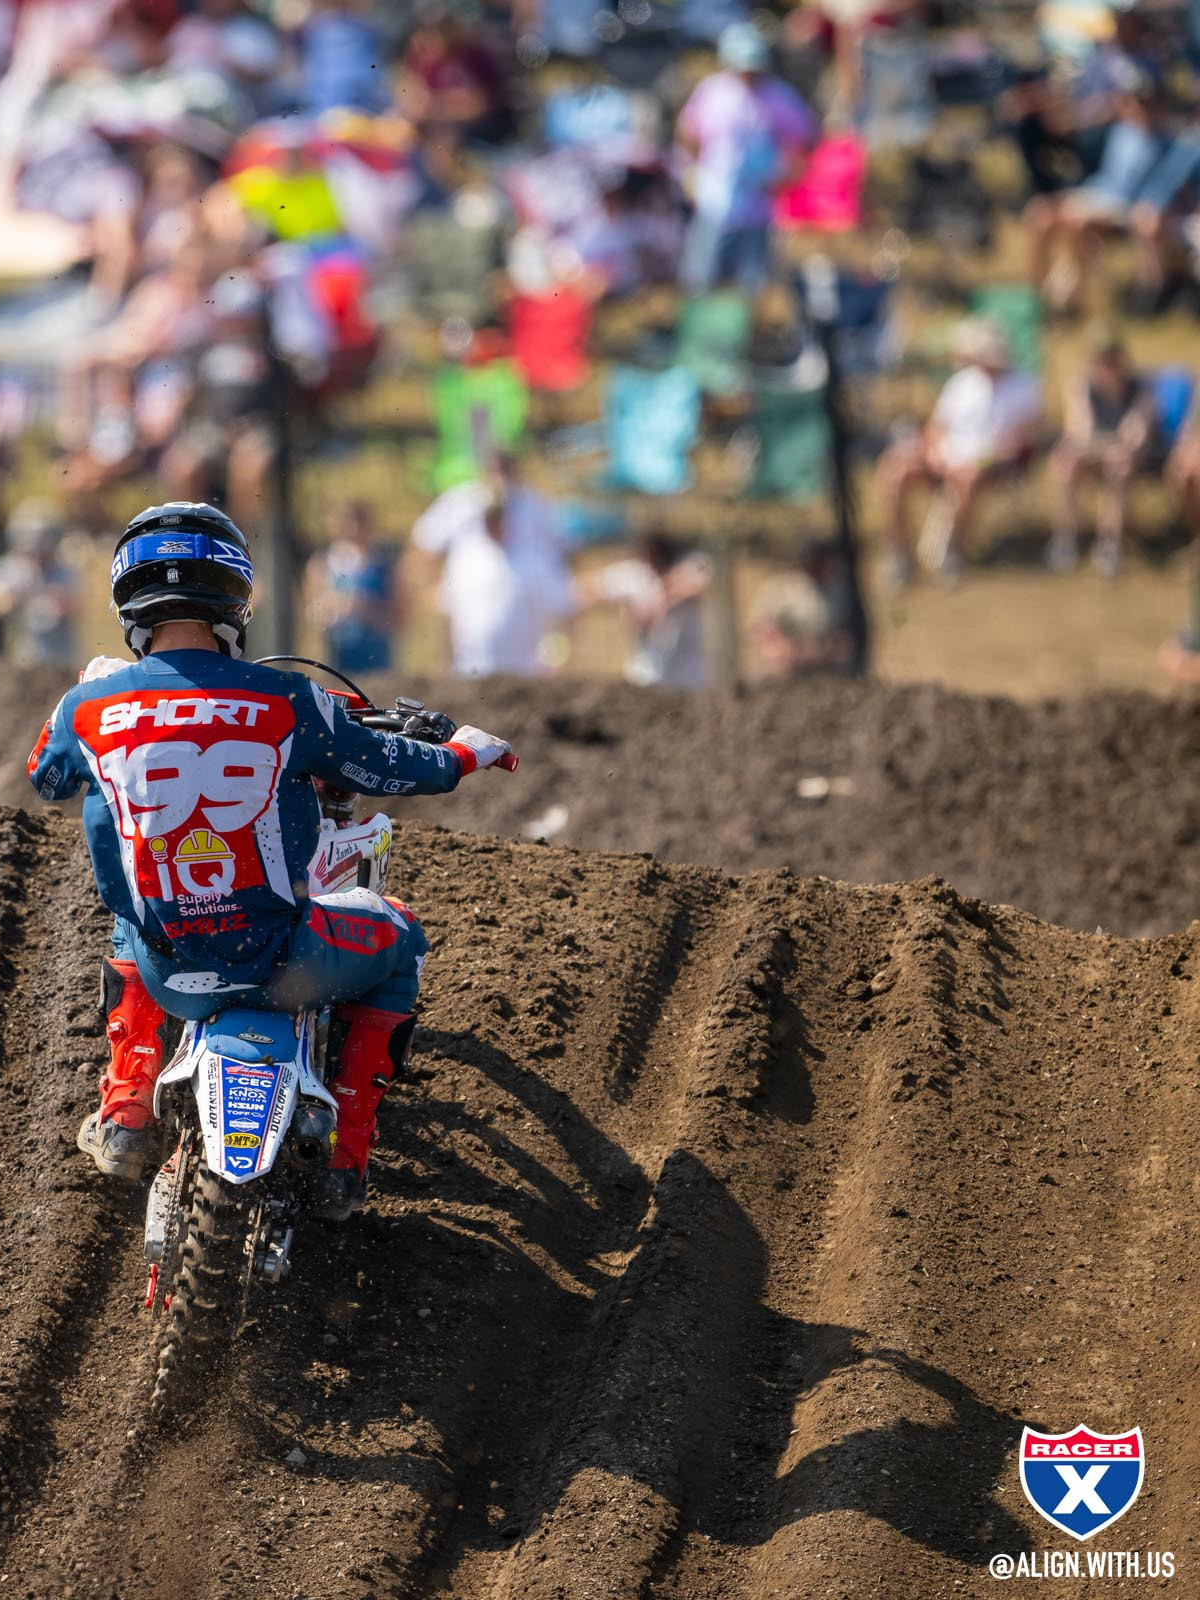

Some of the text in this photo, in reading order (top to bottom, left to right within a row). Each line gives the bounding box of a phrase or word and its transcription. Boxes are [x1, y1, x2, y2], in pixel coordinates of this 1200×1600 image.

[99, 697, 269, 736] SHORT
[98, 740, 281, 839] 199
[177, 891, 222, 904] Supply
[179, 902, 238, 916] Solutions
[229, 1089, 266, 1099] KNOX
[238, 1077, 272, 1088] CEC
[209, 1082, 218, 1129] DUNLOP
[270, 1088, 287, 1134] DUNLOP
